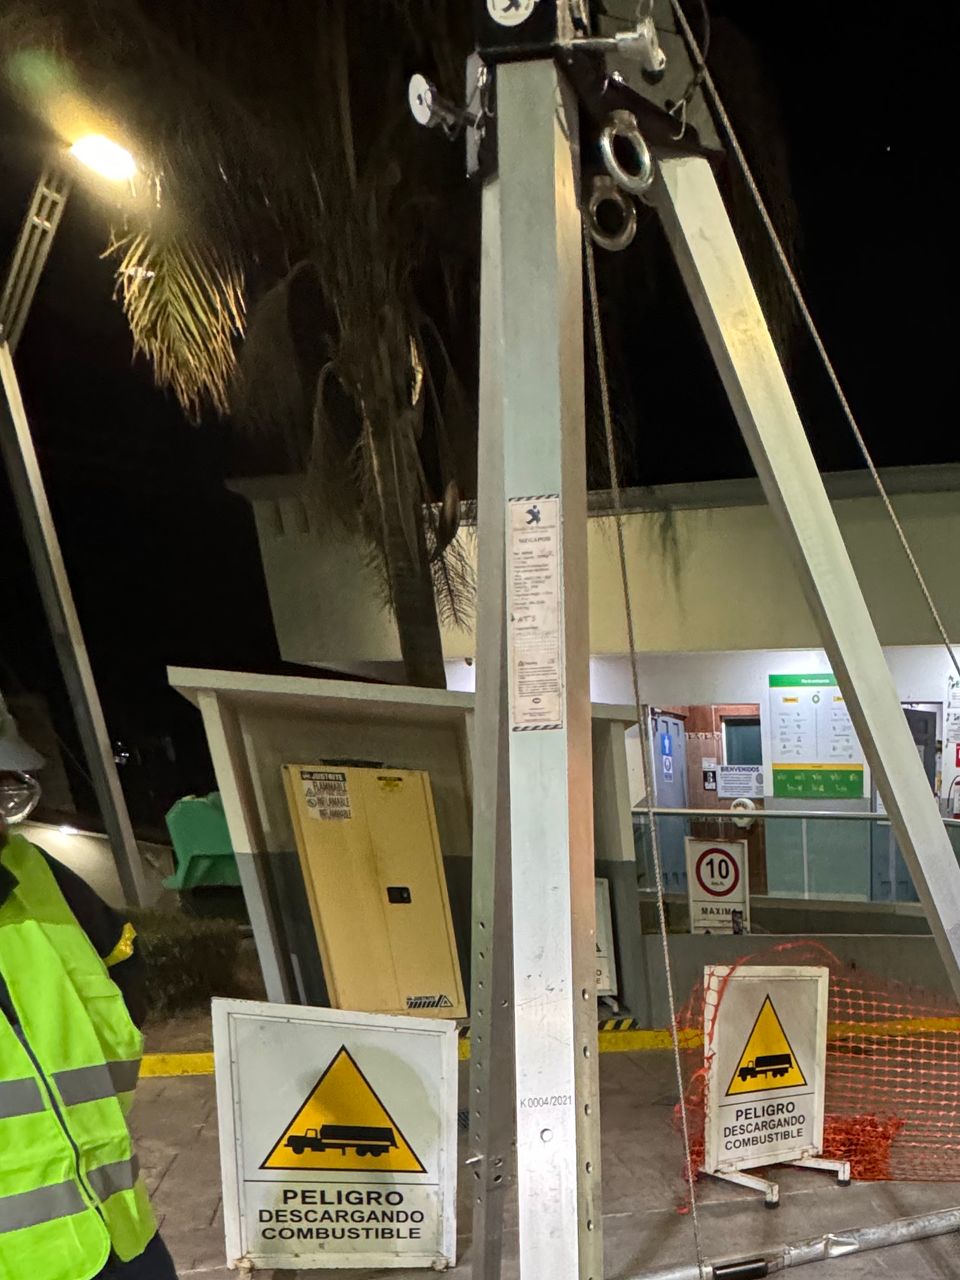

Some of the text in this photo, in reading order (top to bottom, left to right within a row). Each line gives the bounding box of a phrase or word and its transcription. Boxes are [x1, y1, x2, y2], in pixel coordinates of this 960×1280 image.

[706, 858, 729, 879] 10
[736, 1101, 795, 1121] PELIGRO
[723, 1114, 805, 1138] DESCARGANDO
[725, 1128, 803, 1150] COMBUSTIBLE
[283, 1190, 404, 1206] PELIGRO
[258, 1209, 424, 1223] DESCARGANDO
[261, 1227, 421, 1240] COMBUSTIBLE
